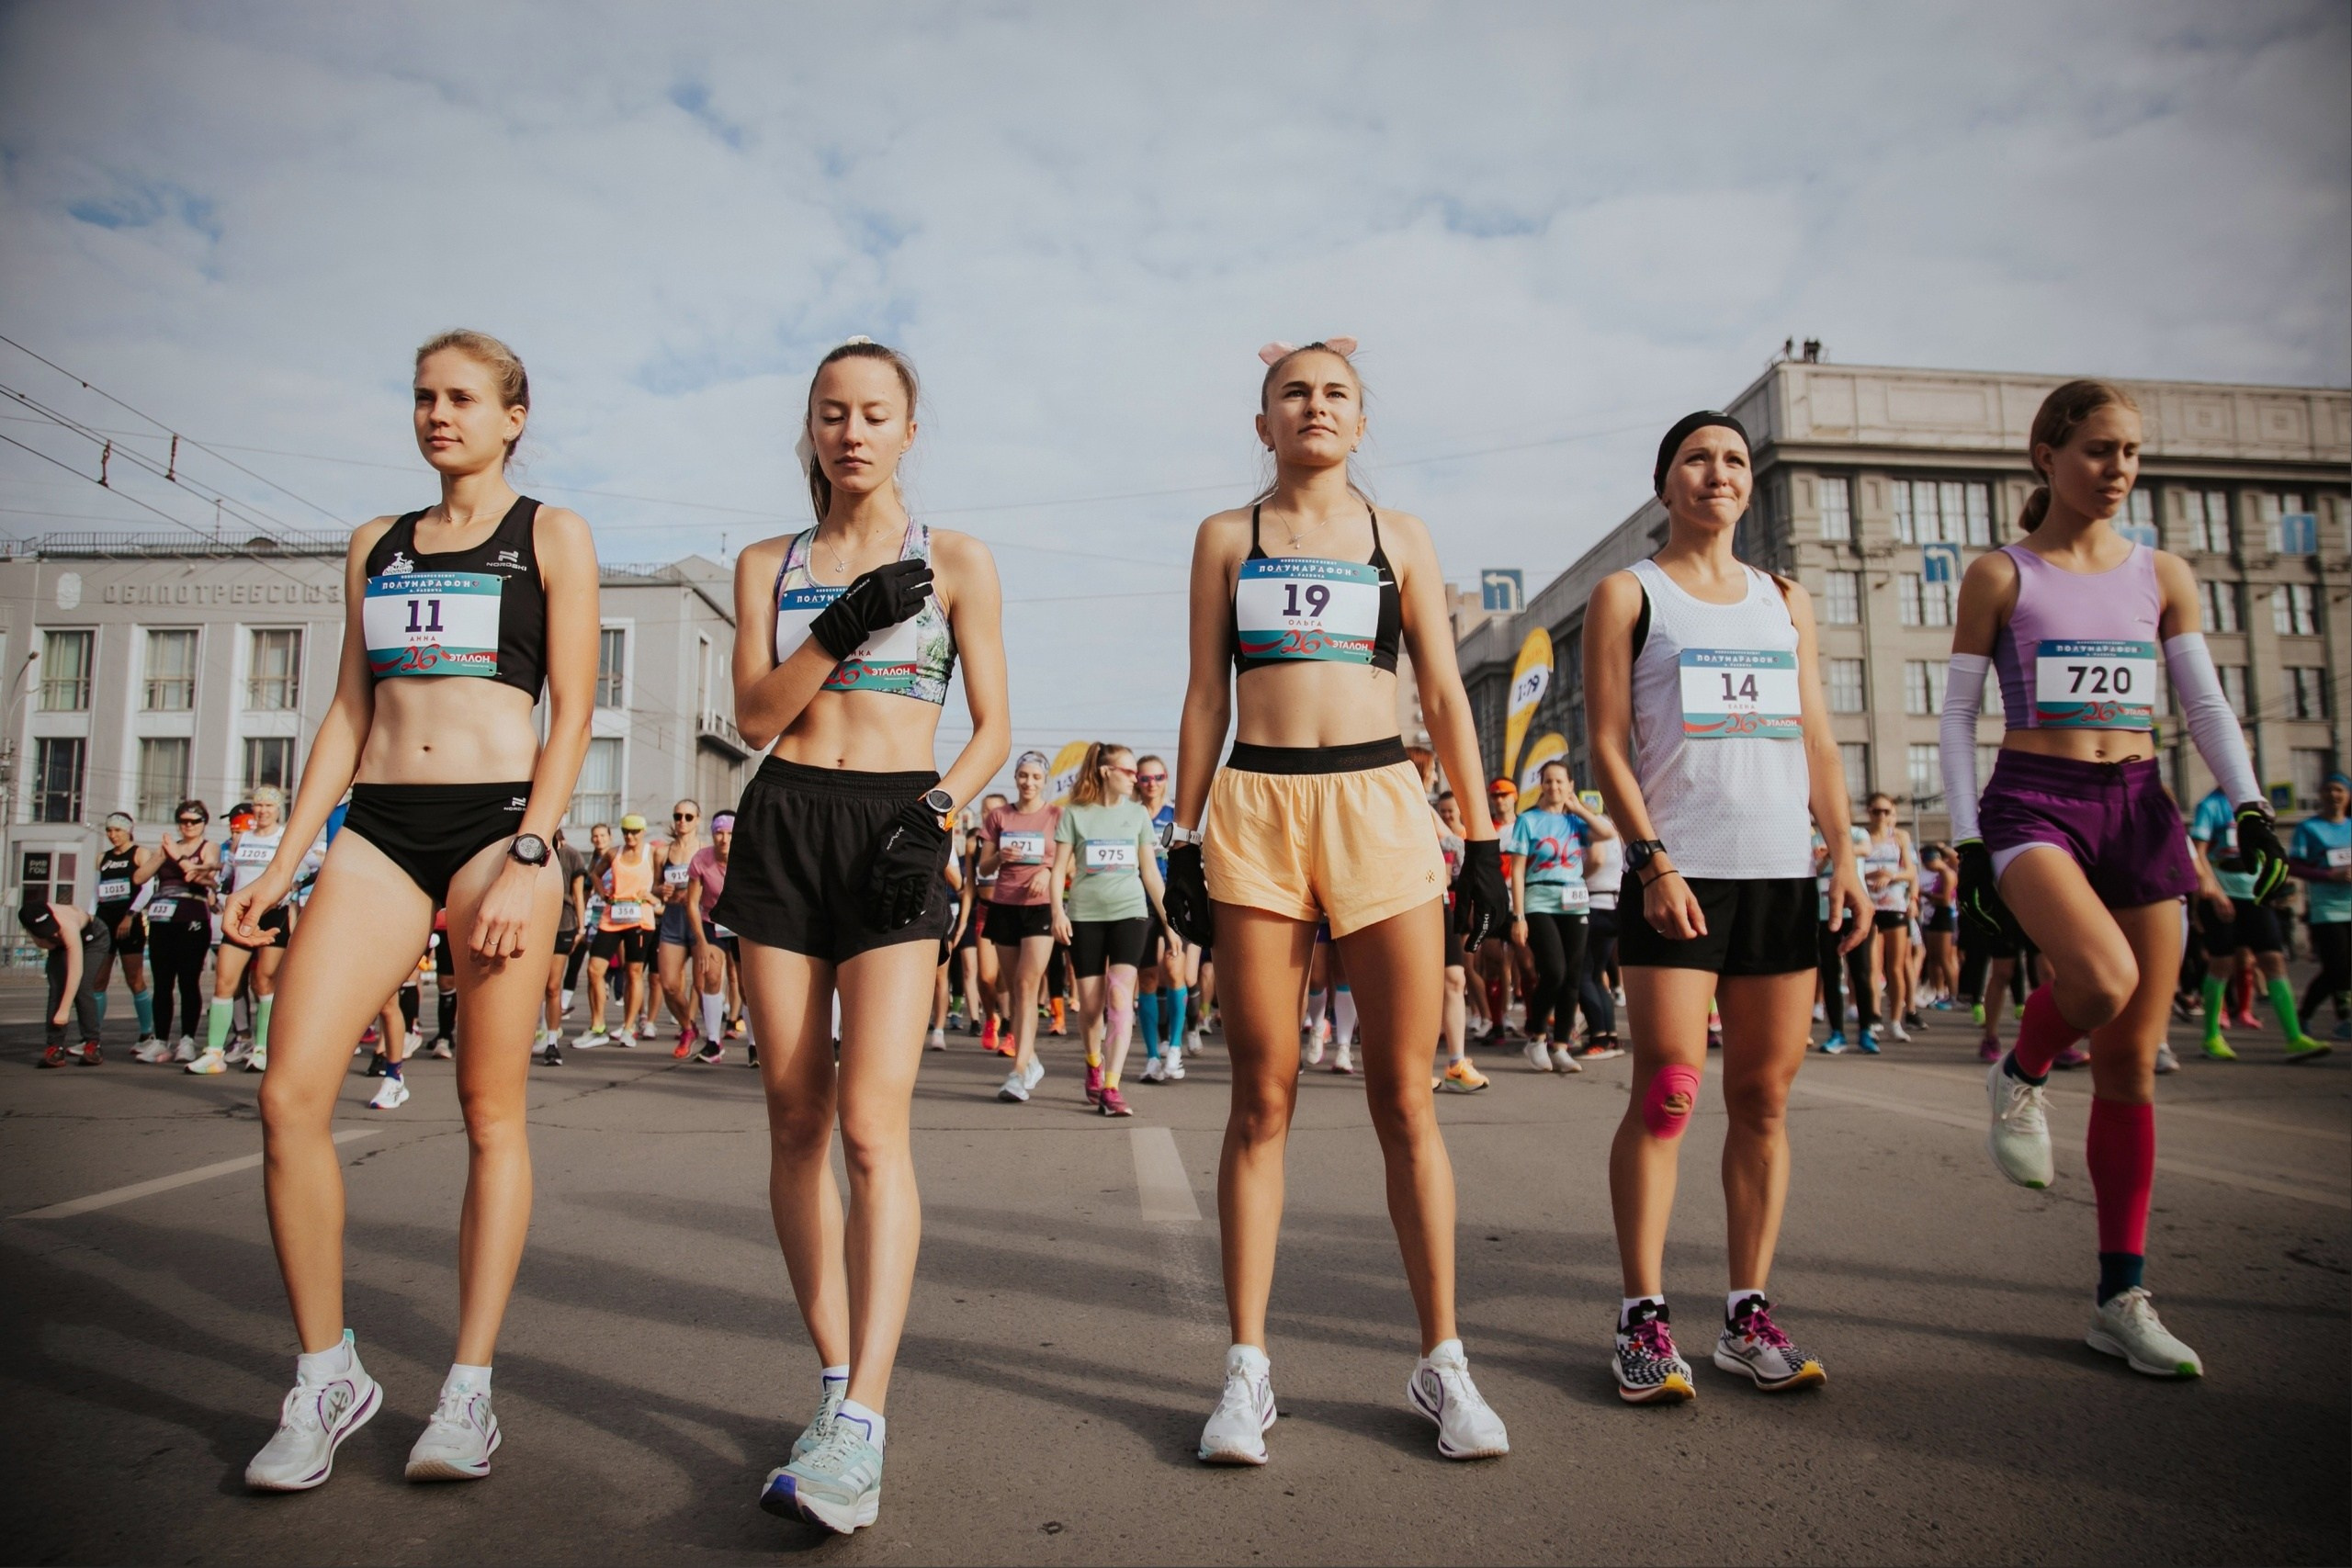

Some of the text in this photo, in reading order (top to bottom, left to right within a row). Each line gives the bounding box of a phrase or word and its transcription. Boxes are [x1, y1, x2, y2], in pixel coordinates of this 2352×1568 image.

[486, 561, 527, 571] NORDSKI
[1259, 564, 1351, 576] ПОЛУМАРАФОН
[382, 580, 470, 590] ПОЛУМАРАФОН
[103, 584, 340, 604] ОБЛПОТРЕБСОЮЗ
[1283, 584, 1330, 617] 19
[404, 599, 443, 633] 11
[1280, 628, 1325, 655] 26
[1332, 640, 1369, 651] ЭТАЛОН
[400, 643, 441, 672] 26
[448, 653, 491, 663] ЭТАЛОН
[1696, 654, 1773, 663] ПОЛУМАРАФОН
[871, 668, 910, 676] ЭТАЛОН
[2067, 666, 2131, 694] 720
[1722, 672, 1758, 702] 14
[2081, 700, 2117, 722] 26
[1724, 711, 1758, 734] 26
[242, 850, 267, 858] 1205
[1099, 849, 1125, 861] 975
[1532, 832, 1582, 874] 26
[105, 886, 125, 894] 1015
